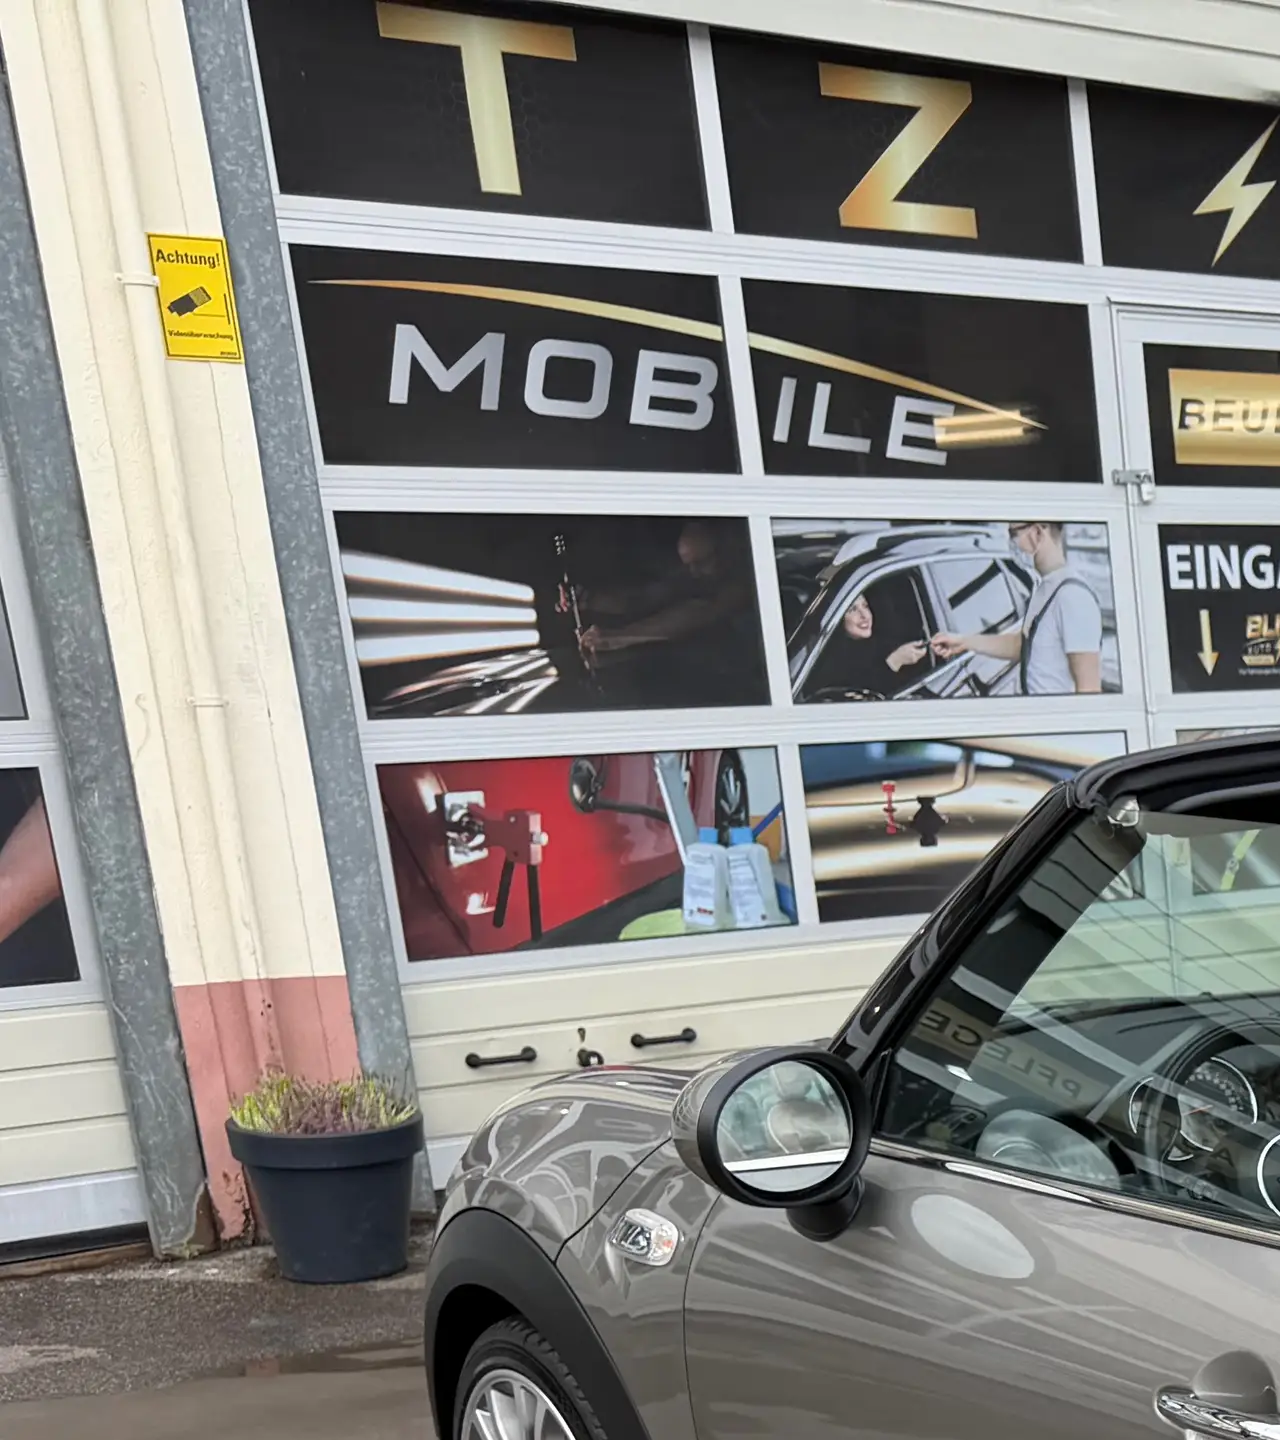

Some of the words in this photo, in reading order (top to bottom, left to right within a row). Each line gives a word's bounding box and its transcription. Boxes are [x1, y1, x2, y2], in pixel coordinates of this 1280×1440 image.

[377, 2, 577, 195] T
[819, 62, 978, 239] Z
[156, 249, 220, 269] Achtung!
